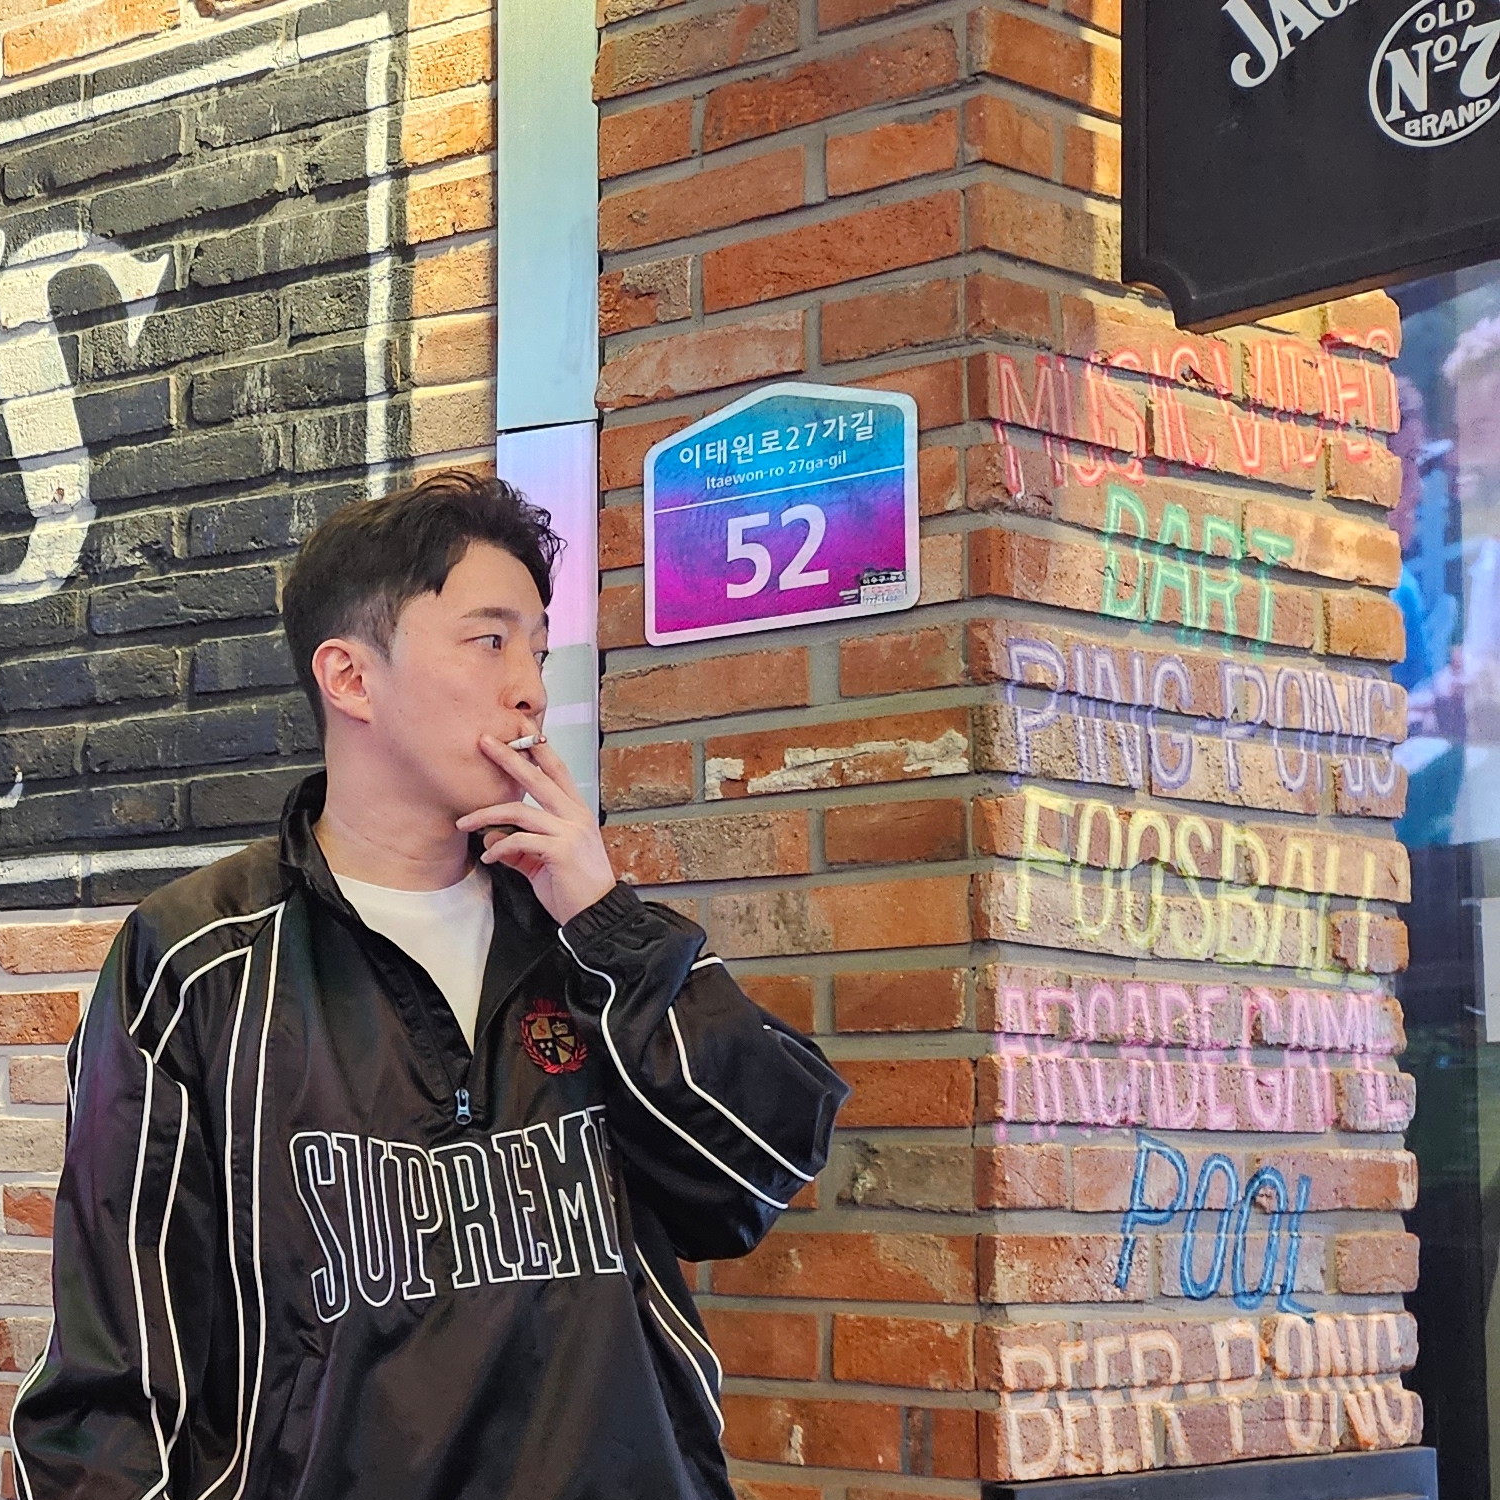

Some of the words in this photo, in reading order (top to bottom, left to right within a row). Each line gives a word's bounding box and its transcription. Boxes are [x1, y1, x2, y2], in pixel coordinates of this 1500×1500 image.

[1415, 0, 1476, 33] OLD
[1404, 98, 1491, 139] BRAND
[678, 409, 875, 469] 이태원로27가길
[706, 463, 784, 490] Itaewon-ro
[788, 449, 848, 474] 27ga-gil
[994, 342, 1218, 498] MUSIC
[1211, 326, 1401, 476] VIDEO
[725, 503, 829, 599] 52
[1101, 485, 1293, 660] DART
[1017, 784, 1381, 991] FOOSBALL
[995, 983, 1237, 1140] ARCADE
[1113, 1130, 1317, 1324] POOL
